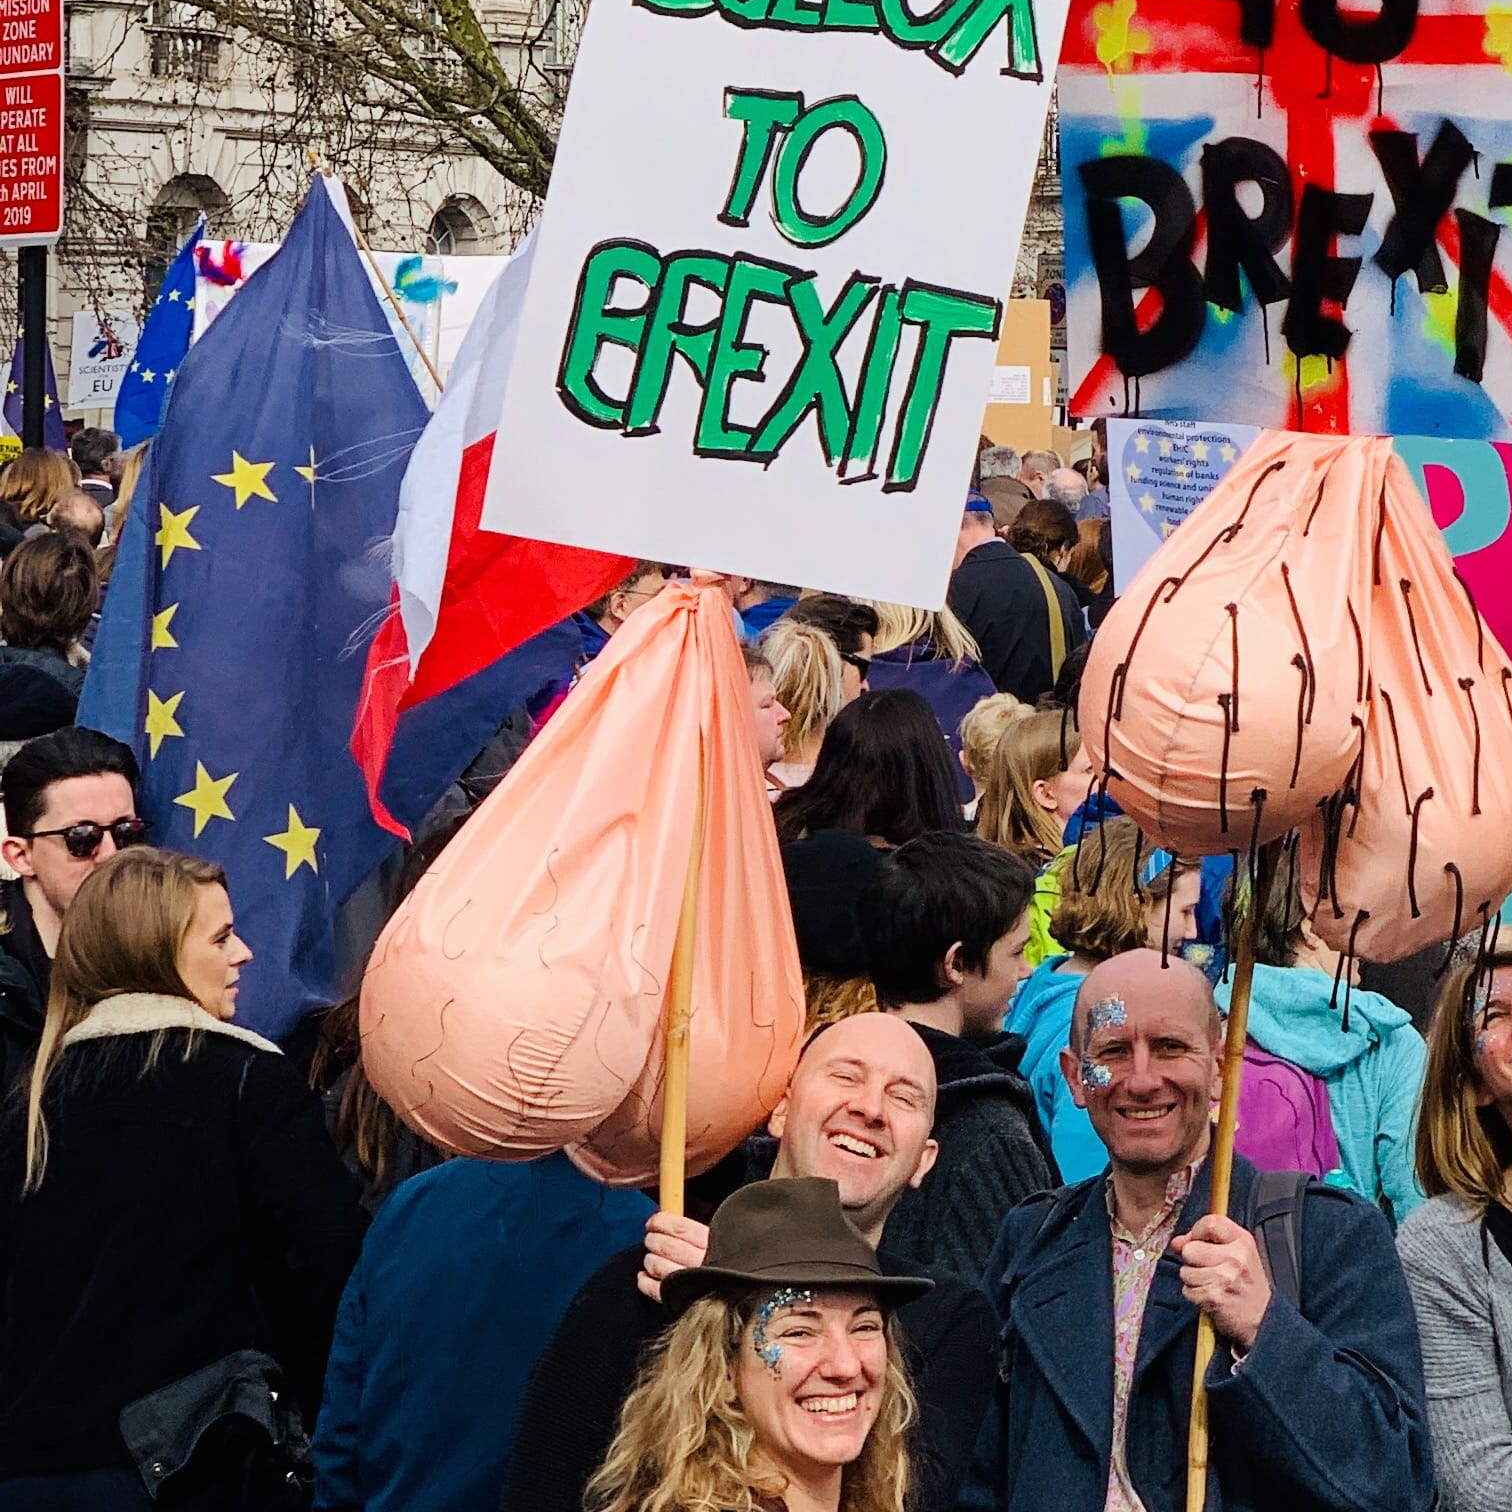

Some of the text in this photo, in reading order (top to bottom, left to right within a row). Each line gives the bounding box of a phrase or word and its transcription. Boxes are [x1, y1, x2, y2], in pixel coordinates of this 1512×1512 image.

[3, 19, 37, 41] ZONE
[5, 85, 33, 105] WILL
[0, 108, 47, 130] PERATE
[0, 133, 39, 153] AT ALL
[0, 155, 57, 178] ES FROM
[718, 86, 888, 250] TO
[11, 181, 47, 201] APRIL
[3, 206, 31, 226] 2019
[93, 379, 113, 393] EU
[1137, 428, 1231, 445] environmental protections
[1151, 466, 1220, 481] regulation of banks
[1186, 458, 1209, 469] rights
[1130, 475, 1158, 487] funding
[1182, 482, 1197, 492] and
[1162, 491, 1184, 503] human
[1155, 503, 1189, 515] renewable
